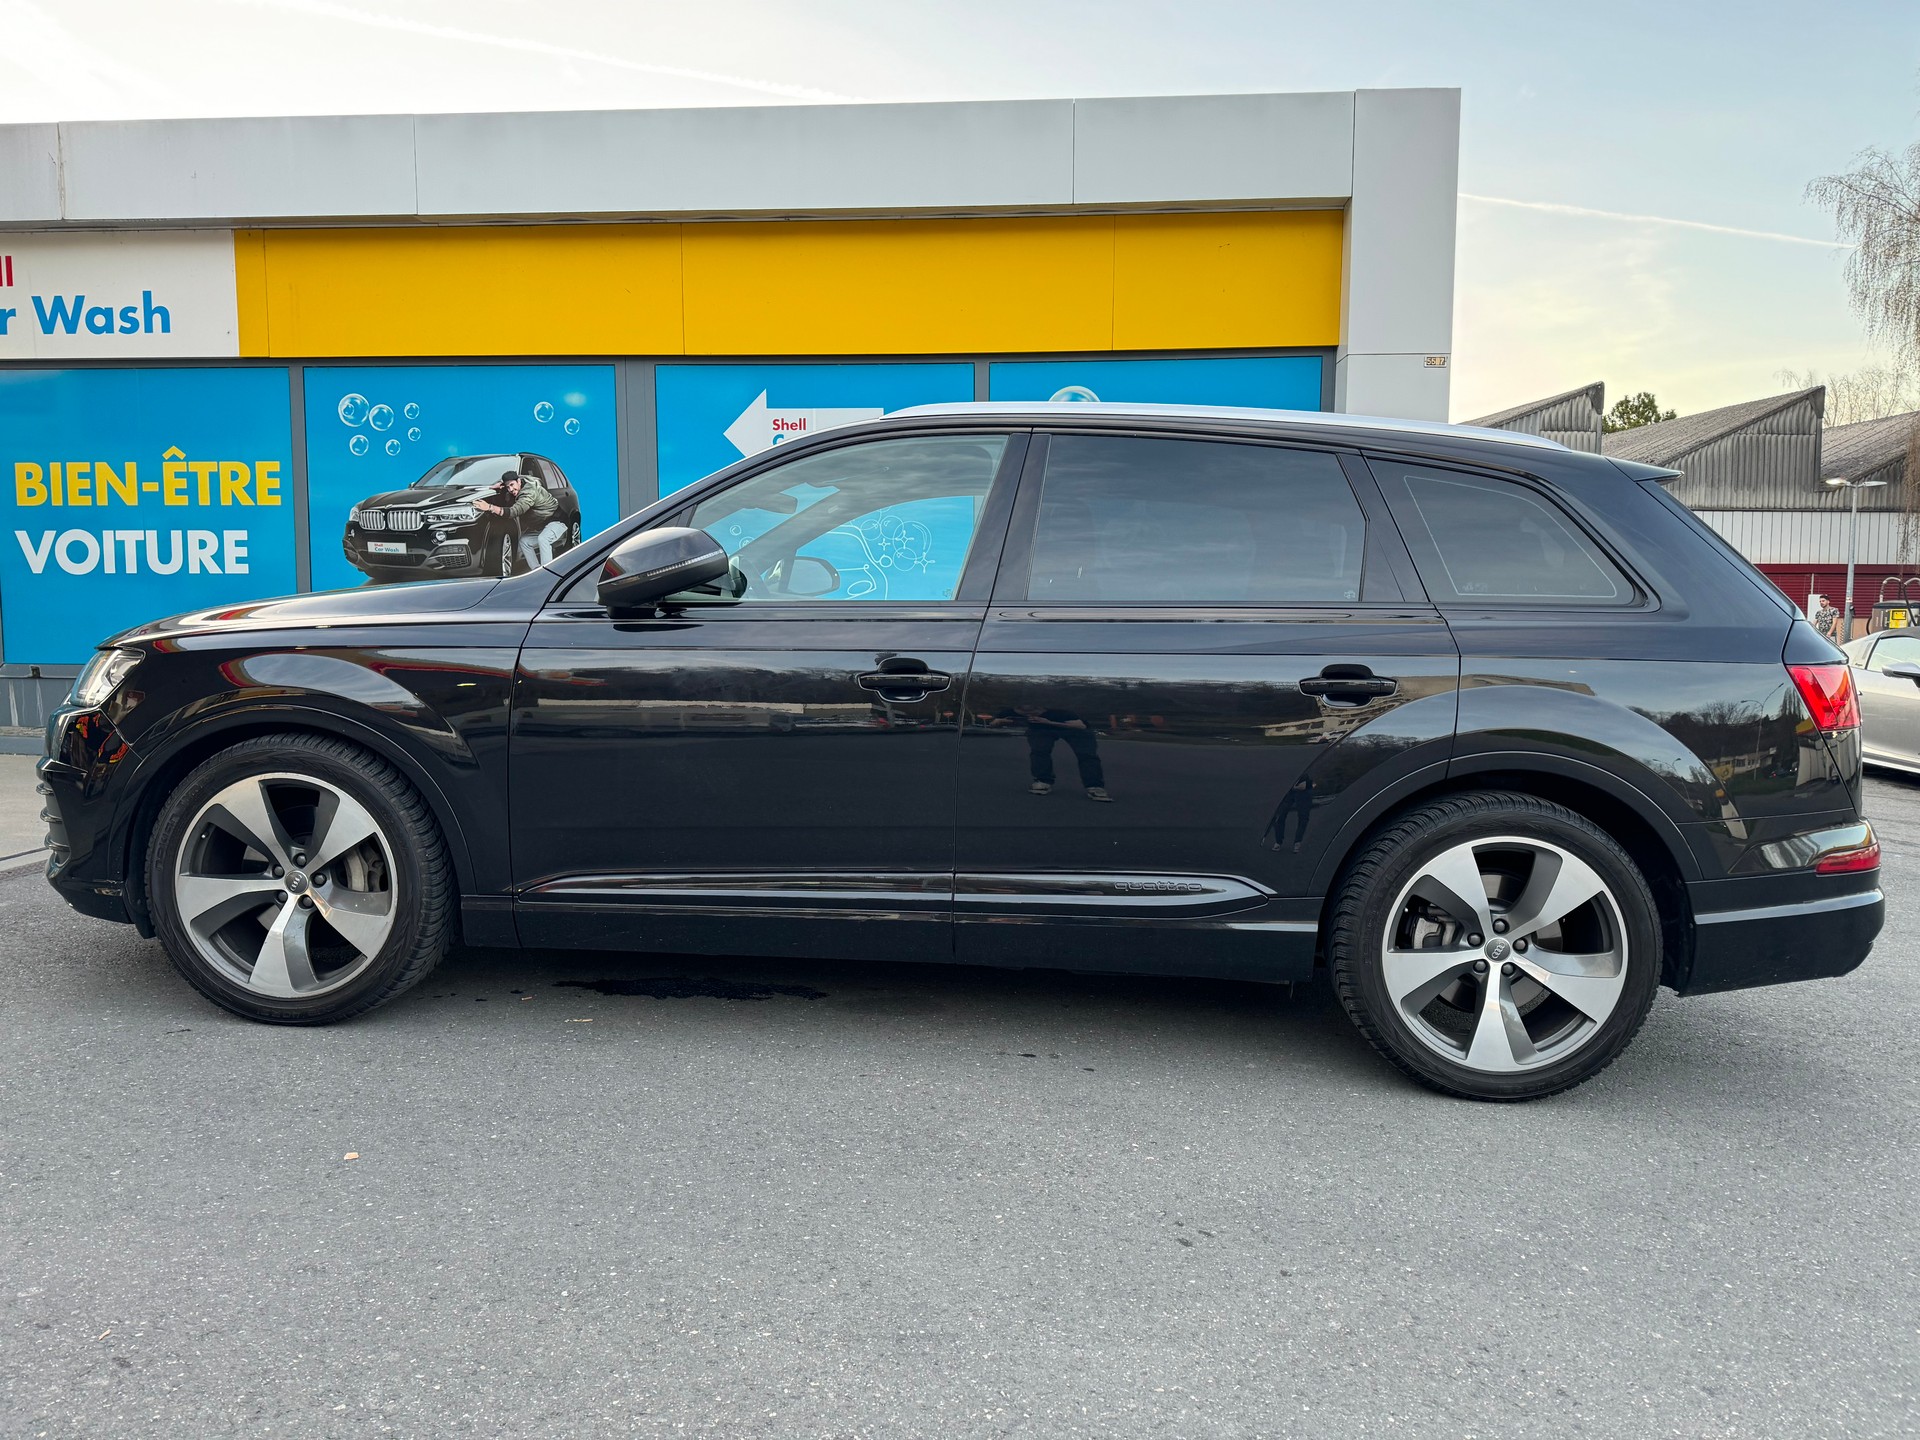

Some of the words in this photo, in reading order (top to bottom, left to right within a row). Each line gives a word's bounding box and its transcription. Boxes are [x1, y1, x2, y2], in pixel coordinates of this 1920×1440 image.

[31, 290, 172, 335] Wash
[772, 418, 807, 431] Shell
[14, 445, 282, 506] BIEN-ÊTRE
[14, 529, 249, 575] VOITURE
[1114, 881, 1203, 892] quattro
